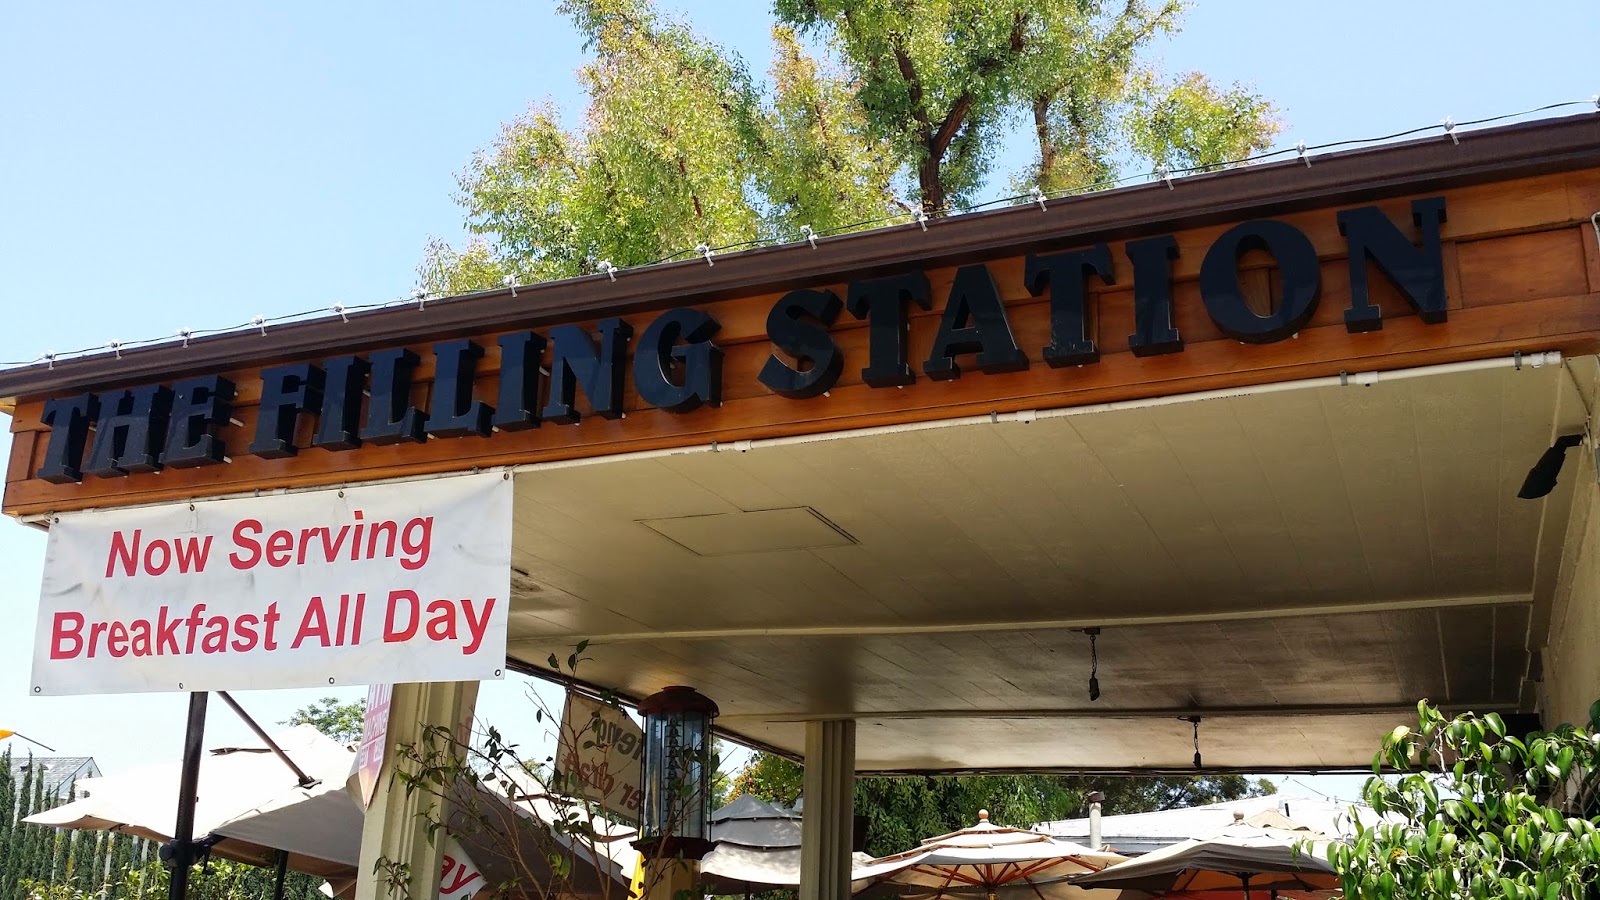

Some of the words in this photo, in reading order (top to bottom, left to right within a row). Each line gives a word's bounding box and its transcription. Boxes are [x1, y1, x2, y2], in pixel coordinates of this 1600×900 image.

[39, 374, 235, 484] THE
[249, 307, 722, 459] FILLING
[758, 195, 1447, 397] STATION
[106, 529, 212, 577] Now
[230, 510, 433, 571] Serving
[50, 603, 281, 660] Breakfast
[292, 593, 366, 648] All
[384, 590, 496, 654] Day
